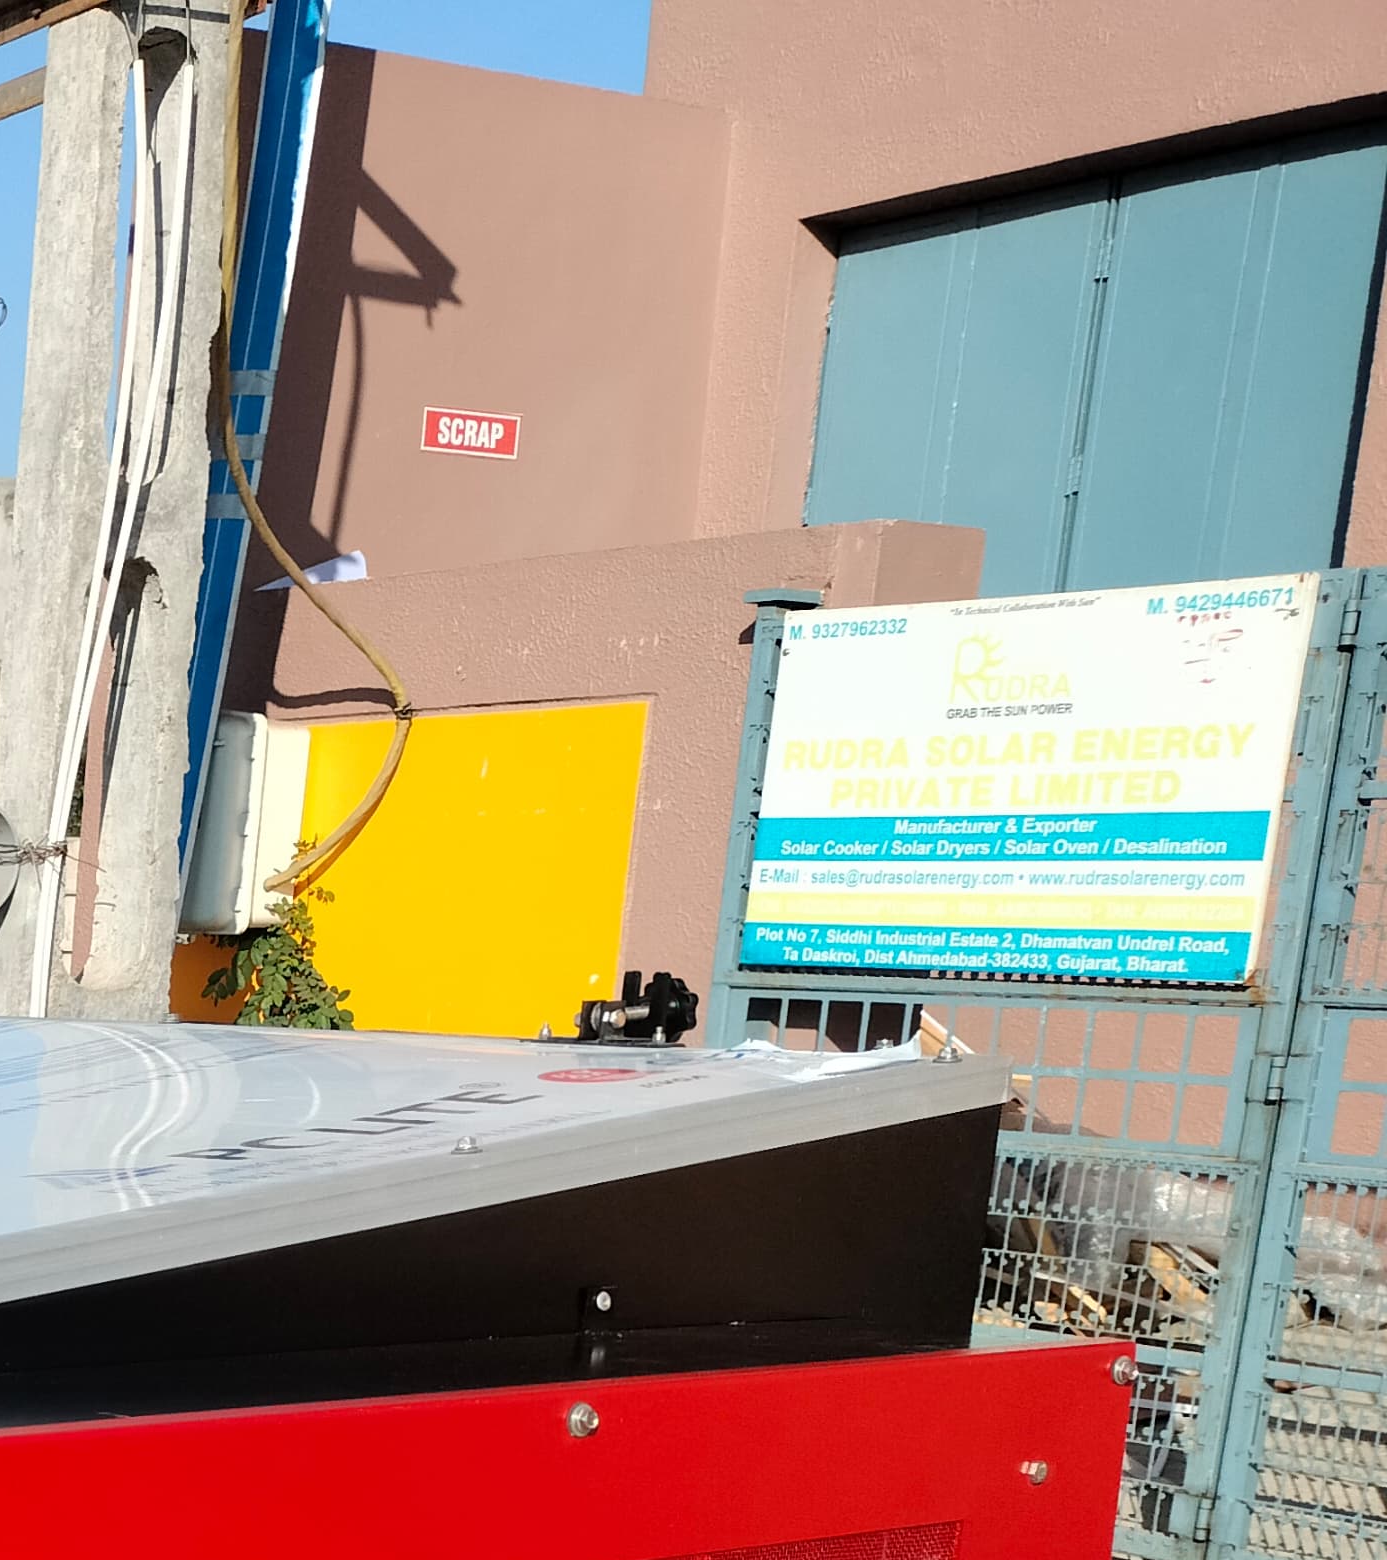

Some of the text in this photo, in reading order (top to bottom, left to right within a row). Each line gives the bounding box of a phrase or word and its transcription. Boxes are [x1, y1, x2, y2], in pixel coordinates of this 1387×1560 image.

[437, 416, 504, 449] SCRAP
[1146, 587, 1294, 615] M. 9429446671
[789, 618, 908, 640] M. 9327962332
[947, 703, 1073, 719] GRAB THE SUN POWER
[782, 723, 1255, 771] RUDRA SOLAR ENERGY
[829, 769, 1182, 809] PRIVATE LIMITED
[894, 817, 1098, 836] Manufacturer & Exporter
[781, 840, 819, 856] Solar
[823, 840, 879, 856] Cooker
[891, 840, 933, 856] Solar
[936, 839, 990, 858] Dryers
[1004, 839, 1049, 855] Solar
[1053, 839, 1099, 855] Oven
[1113, 838, 1227, 855] Desalination
[760, 868, 799, 883] E-Mail
[811, 869, 1014, 889] sales@rudrasolarenergy.com
[1028, 870, 1245, 890] www.rudrasolarenergy.com
[756, 927, 784, 942] Plot
[786, 928, 807, 943] No
[826, 929, 872, 945] Siddhi
[876, 931, 946, 947] Industrial
[949, 932, 999, 948] Estate
[1002, 933, 1016, 949] 2,
[1020, 934, 1113, 950] Dhamatvan
[1178, 936, 1230, 955] Road,
[783, 947, 1188, 974] Ta Daskroi, Dist Ahmedabad-382433, Gujarat, Bharat.
[167, 1091, 545, 1160] PC LITE
